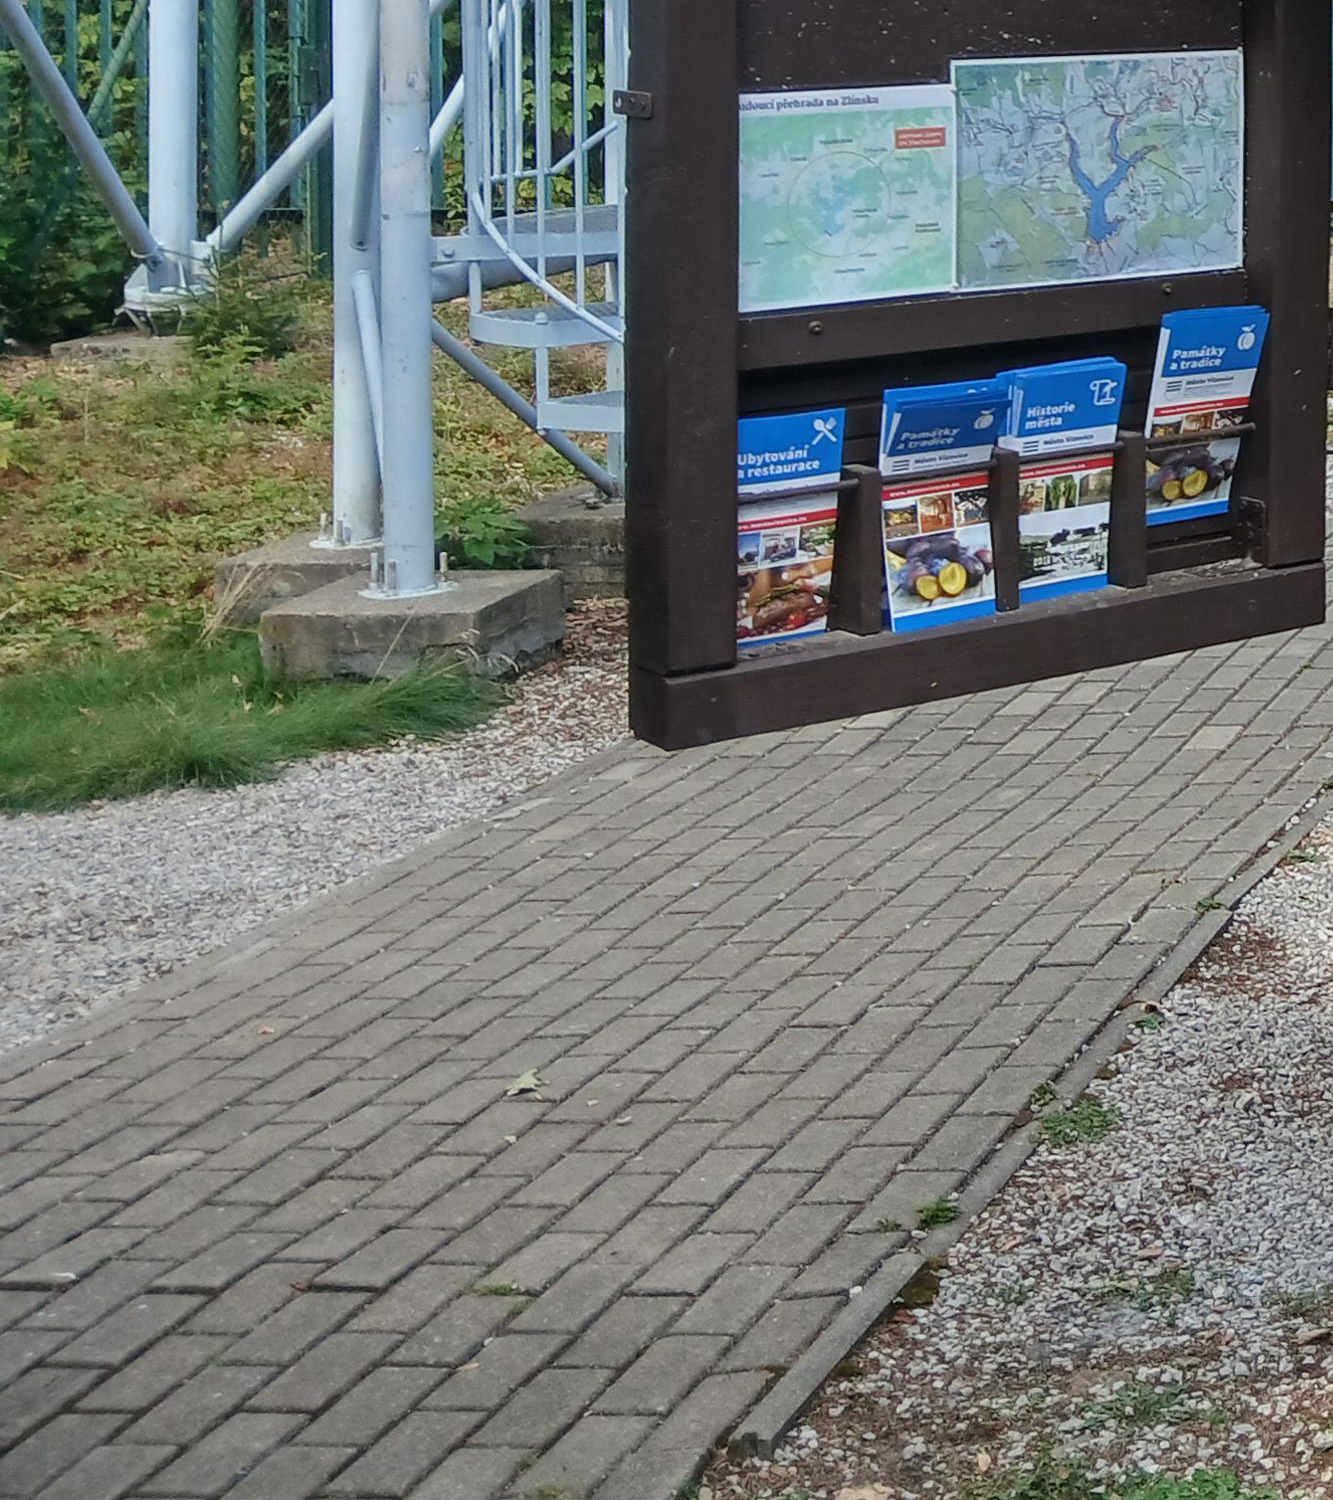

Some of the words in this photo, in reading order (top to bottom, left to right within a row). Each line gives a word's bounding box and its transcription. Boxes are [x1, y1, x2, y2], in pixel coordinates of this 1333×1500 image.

[1172, 345, 1226, 360] Památky
[1170, 362, 1178, 370] a
[1180, 356, 1223, 370] tradice
[1026, 401, 1076, 419] Historie
[1024, 413, 1063, 429] města
[901, 426, 960, 442] Památky
[908, 436, 955, 449] tradice
[747, 460, 821, 479] restaurace
